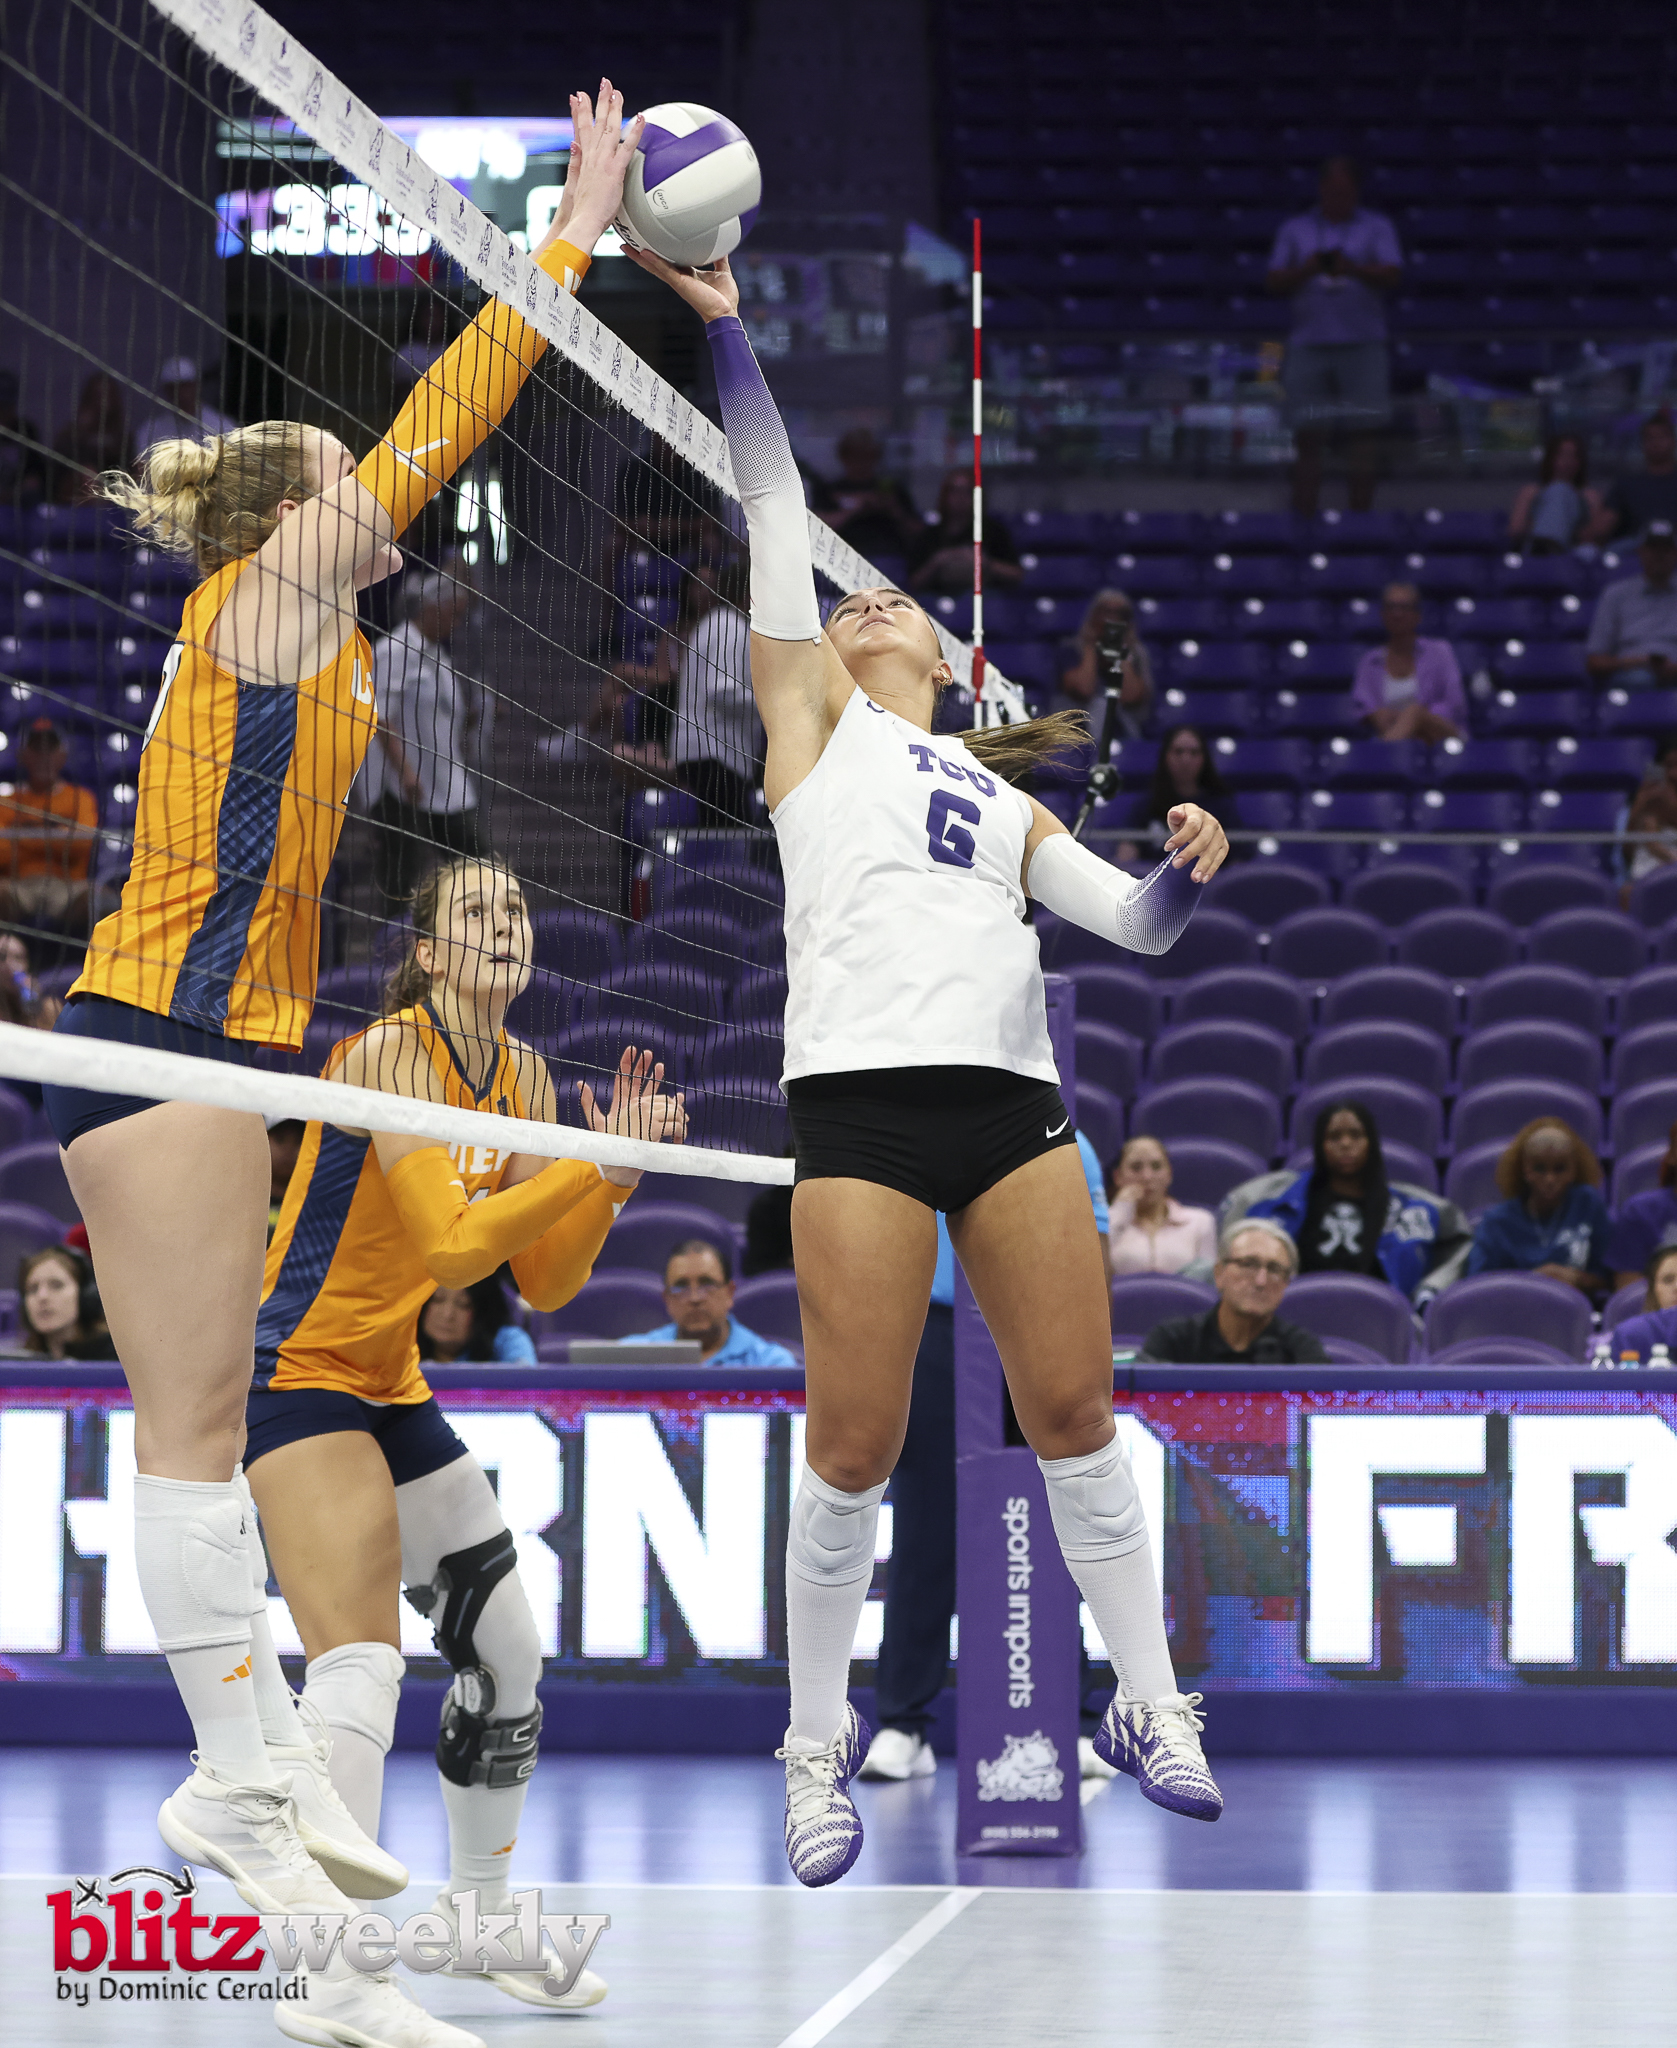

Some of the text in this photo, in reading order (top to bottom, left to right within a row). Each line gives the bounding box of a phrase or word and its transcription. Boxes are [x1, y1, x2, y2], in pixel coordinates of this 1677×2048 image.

[908, 744, 997, 798] TCU
[1001, 1497, 1035, 1709] sports imports
